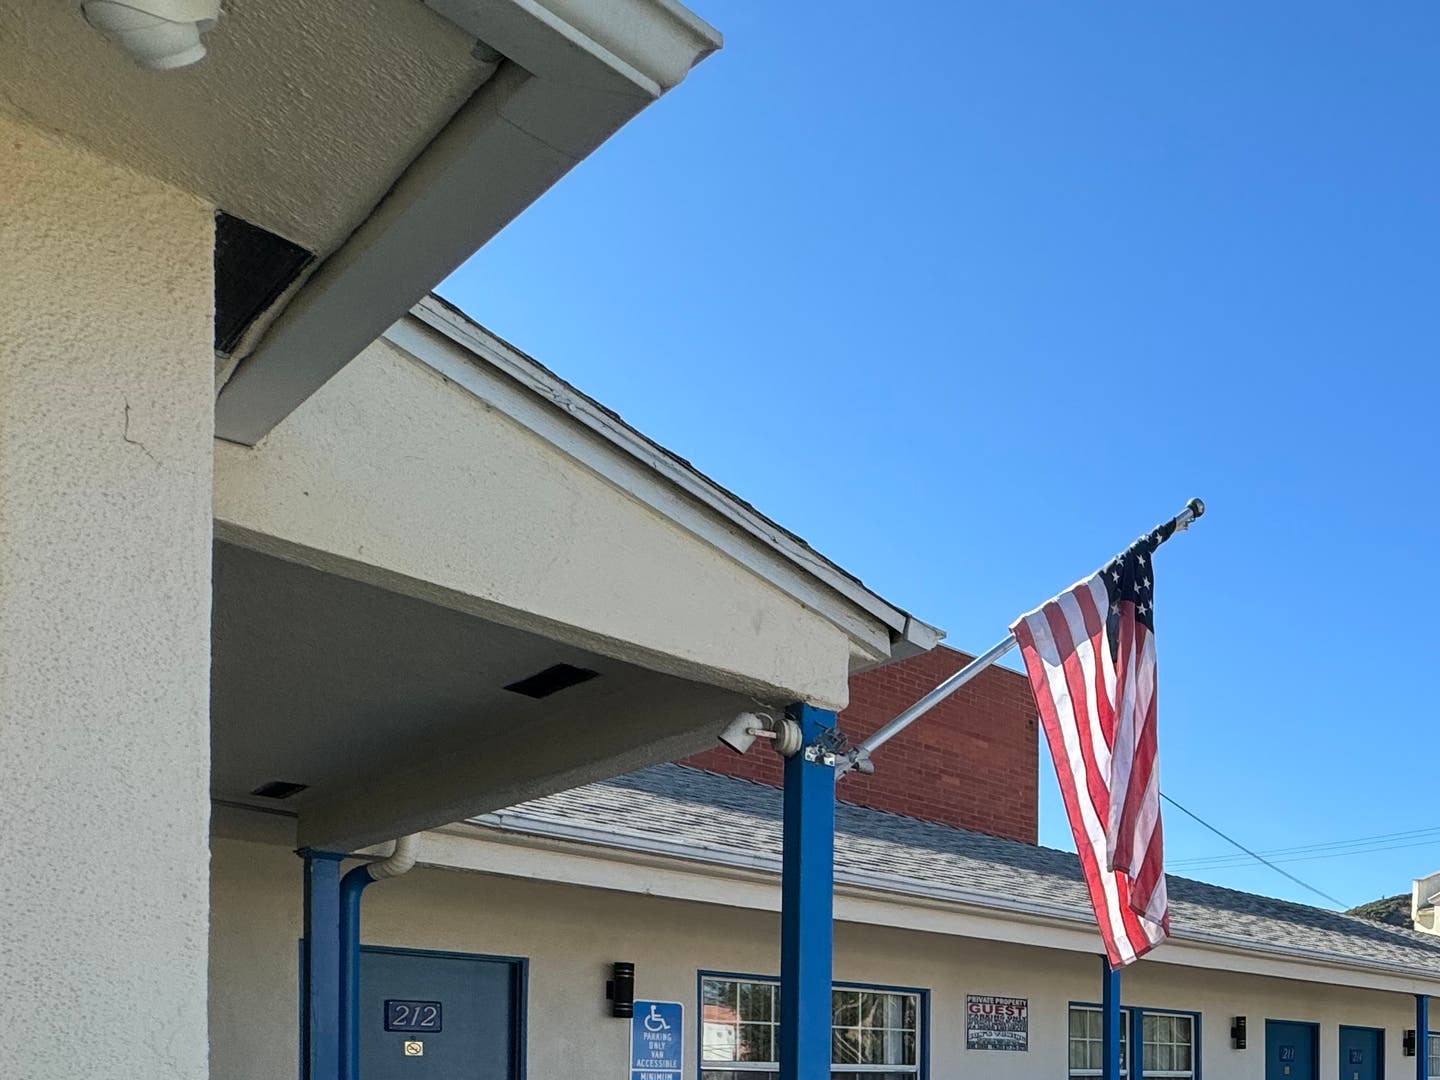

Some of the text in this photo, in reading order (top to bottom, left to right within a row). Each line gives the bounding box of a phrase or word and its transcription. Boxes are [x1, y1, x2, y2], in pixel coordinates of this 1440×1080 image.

[968, 996, 1027, 1006] PRIVATE PROPERTY
[969, 1004, 1025, 1016] GUEST
[392, 1005, 437, 1026] 212
[643, 1032, 672, 1041] PARKING
[648, 1042, 666, 1050] ONLY
[636, 1059, 677, 1068] ACCESSIBLE
